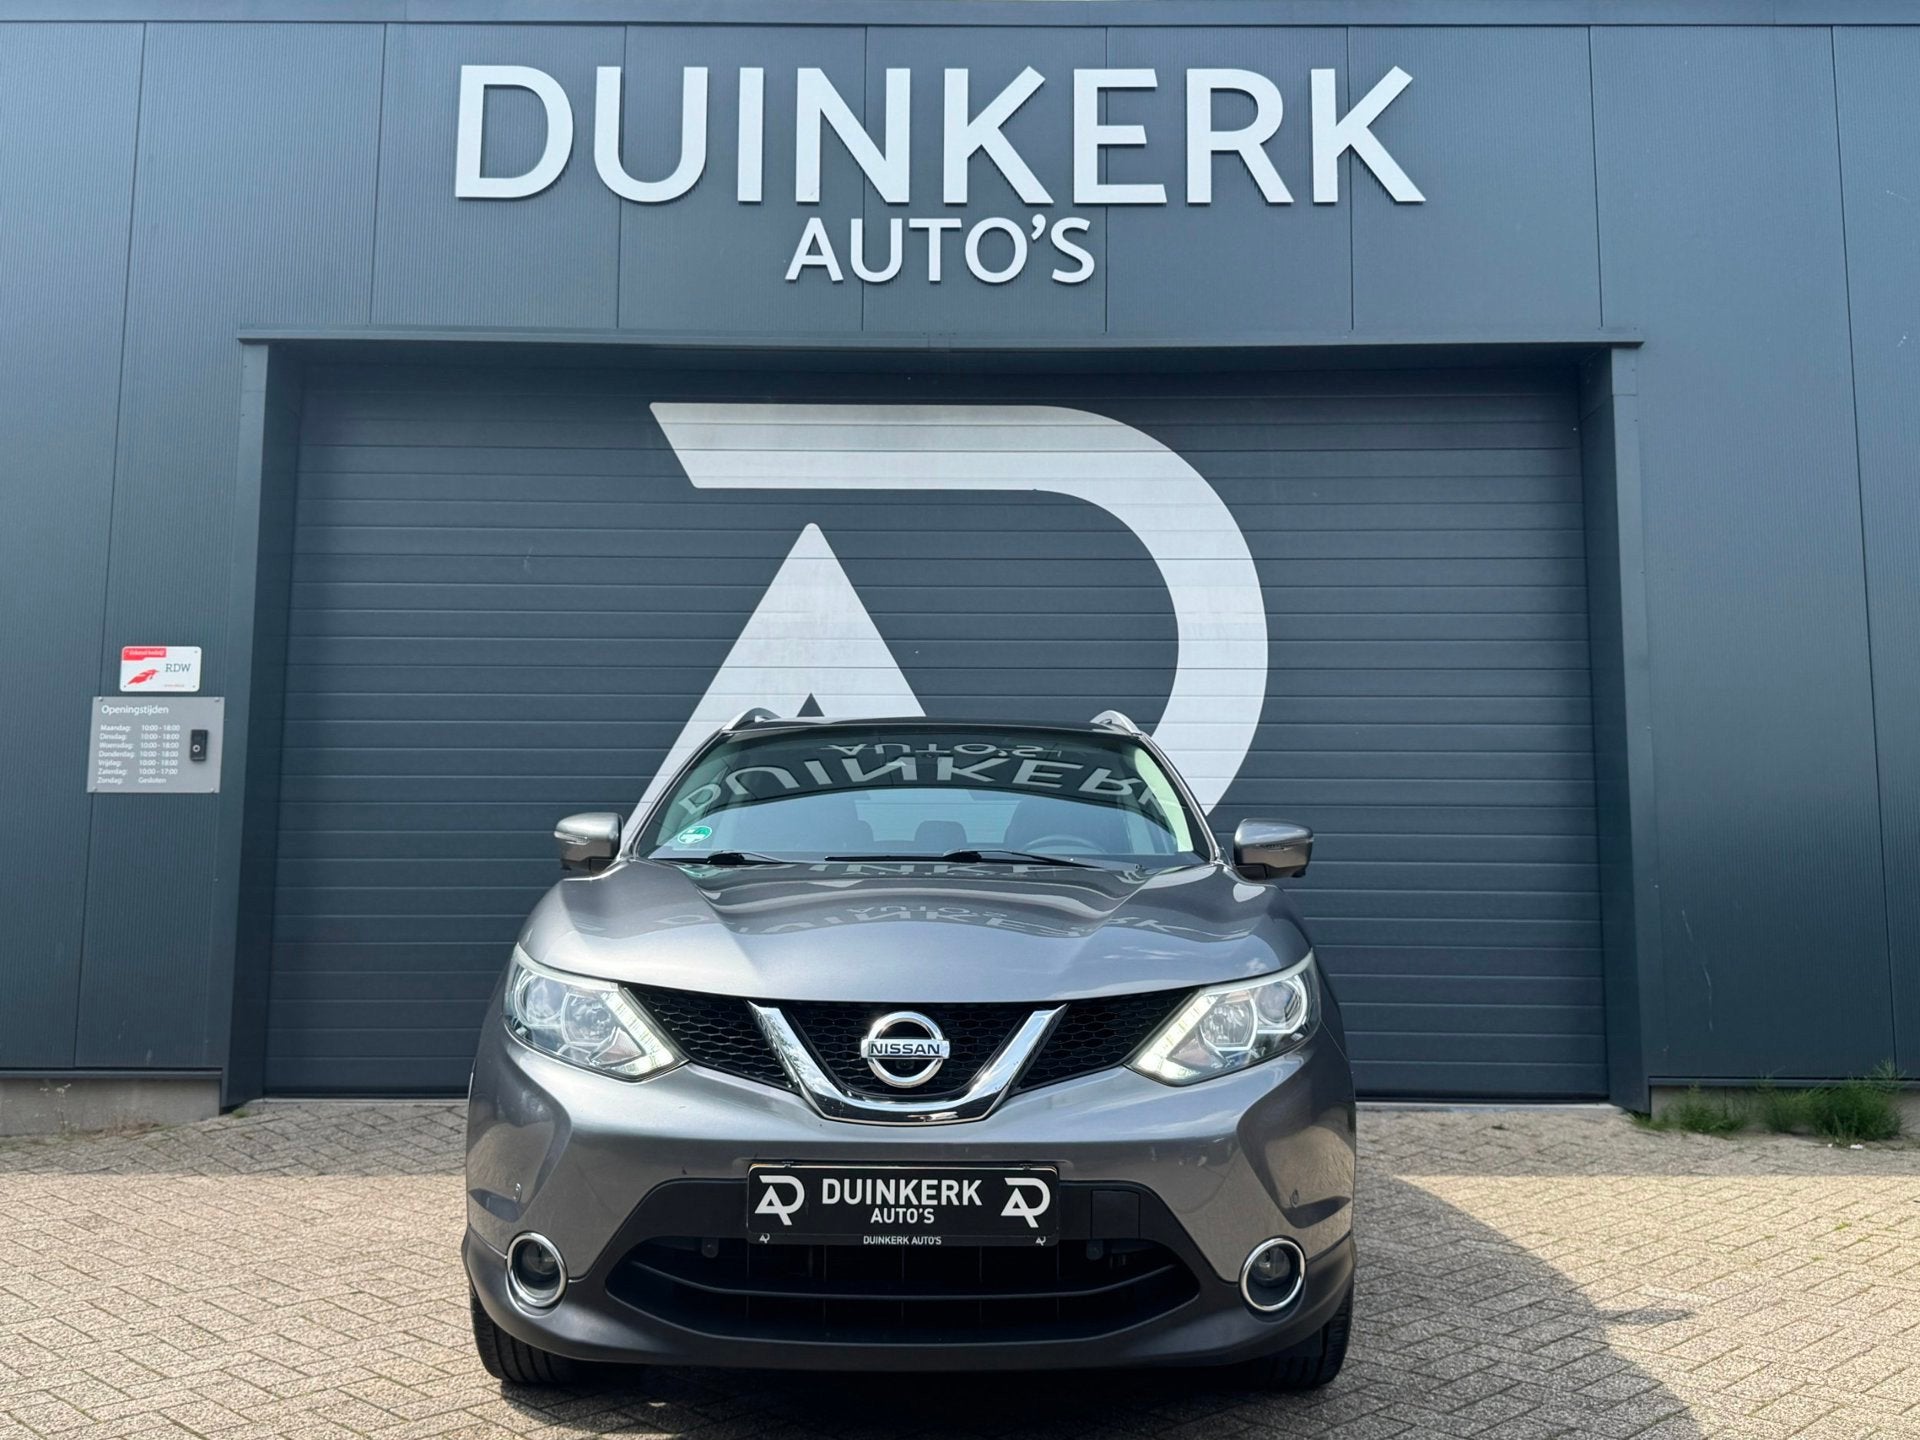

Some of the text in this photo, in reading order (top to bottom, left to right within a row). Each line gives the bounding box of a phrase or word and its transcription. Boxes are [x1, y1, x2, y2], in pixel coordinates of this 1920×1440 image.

[455, 65, 1427, 205] DUINKERK
[785, 213, 1095, 284] AUTO'S
[165, 663, 191, 673] RDW
[101, 704, 169, 716] Openingstijden
[870, 1043, 940, 1054] NISSAN
[822, 1178, 983, 1206] DUINKERK
[870, 1208, 935, 1225] AUTO'S
[863, 1236, 942, 1245] DUINKERK AUTO'S
